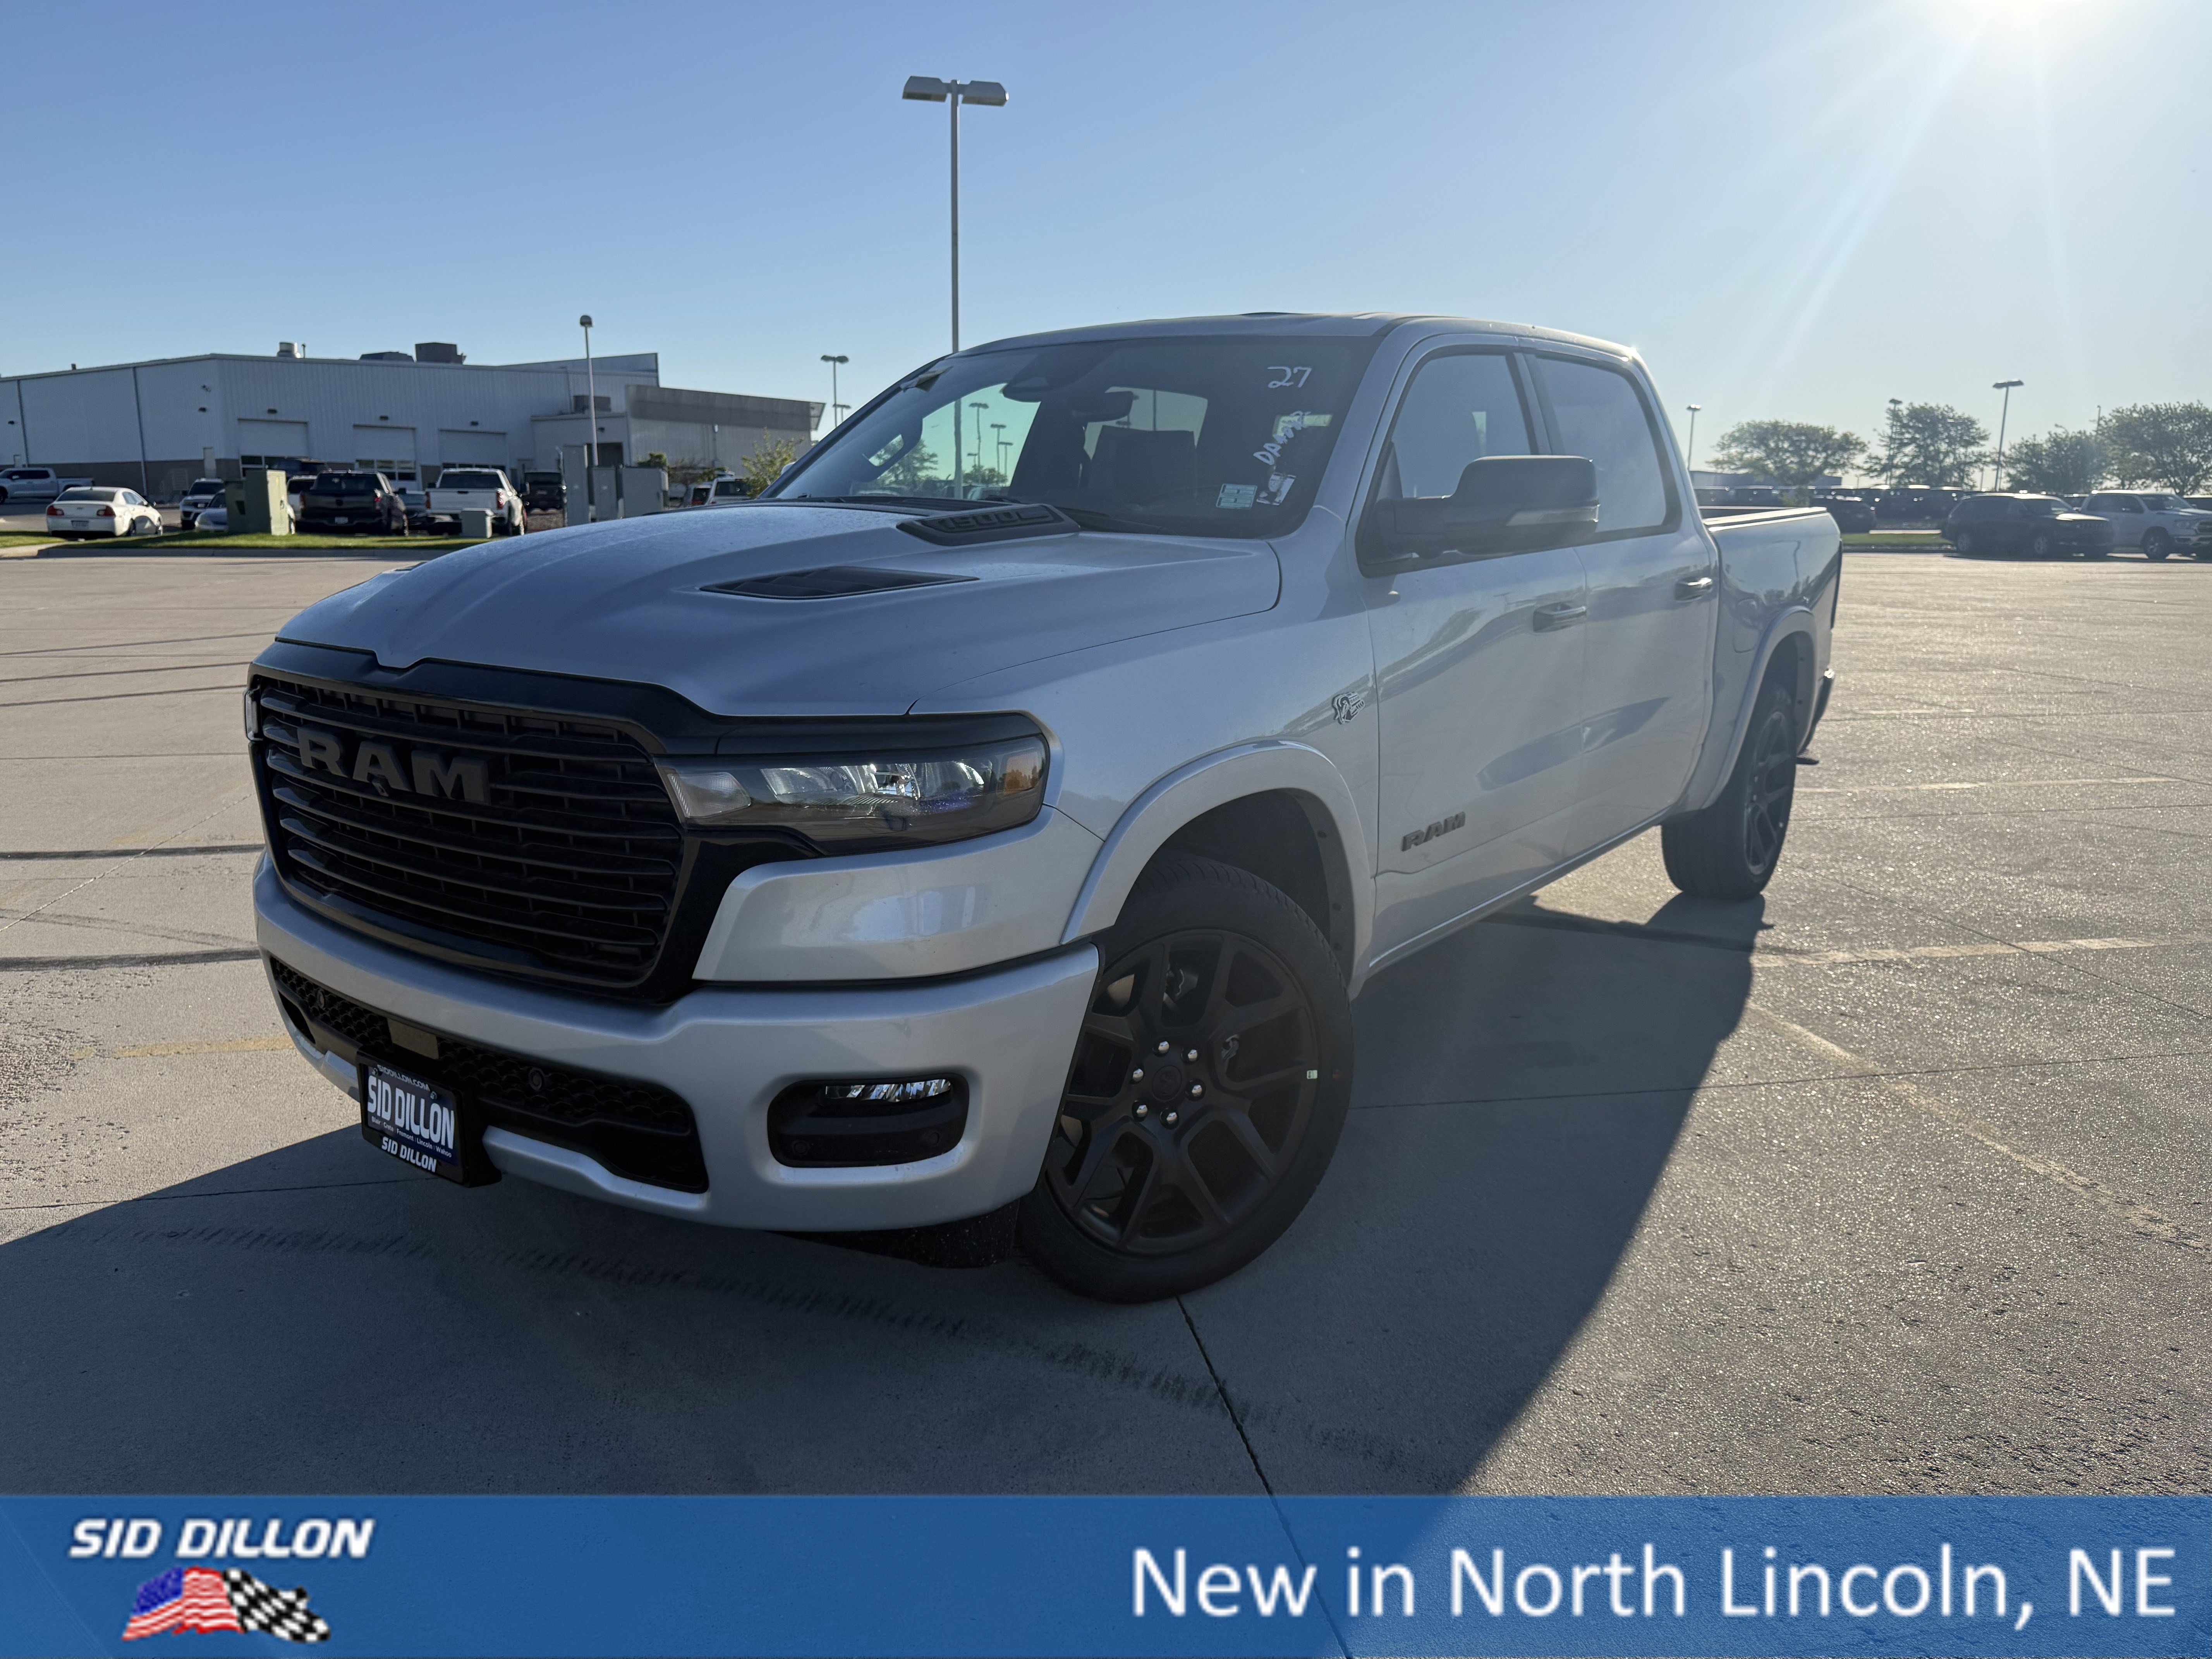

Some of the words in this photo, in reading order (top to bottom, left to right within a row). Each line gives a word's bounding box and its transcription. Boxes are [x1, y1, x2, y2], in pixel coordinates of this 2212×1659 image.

[1267, 366, 1312, 388] 27
[938, 511, 1019, 529] 1500
[297, 727, 491, 804] RAM
[1400, 811, 1466, 852] RAM
[367, 1075, 392, 1121] SID
[395, 1087, 455, 1149] DILLON
[381, 1136, 398, 1155] SID
[400, 1144, 437, 1173] DILLON
[397, 1128, 414, 1142] Fremont
[417, 1138, 433, 1150] Lincoln
